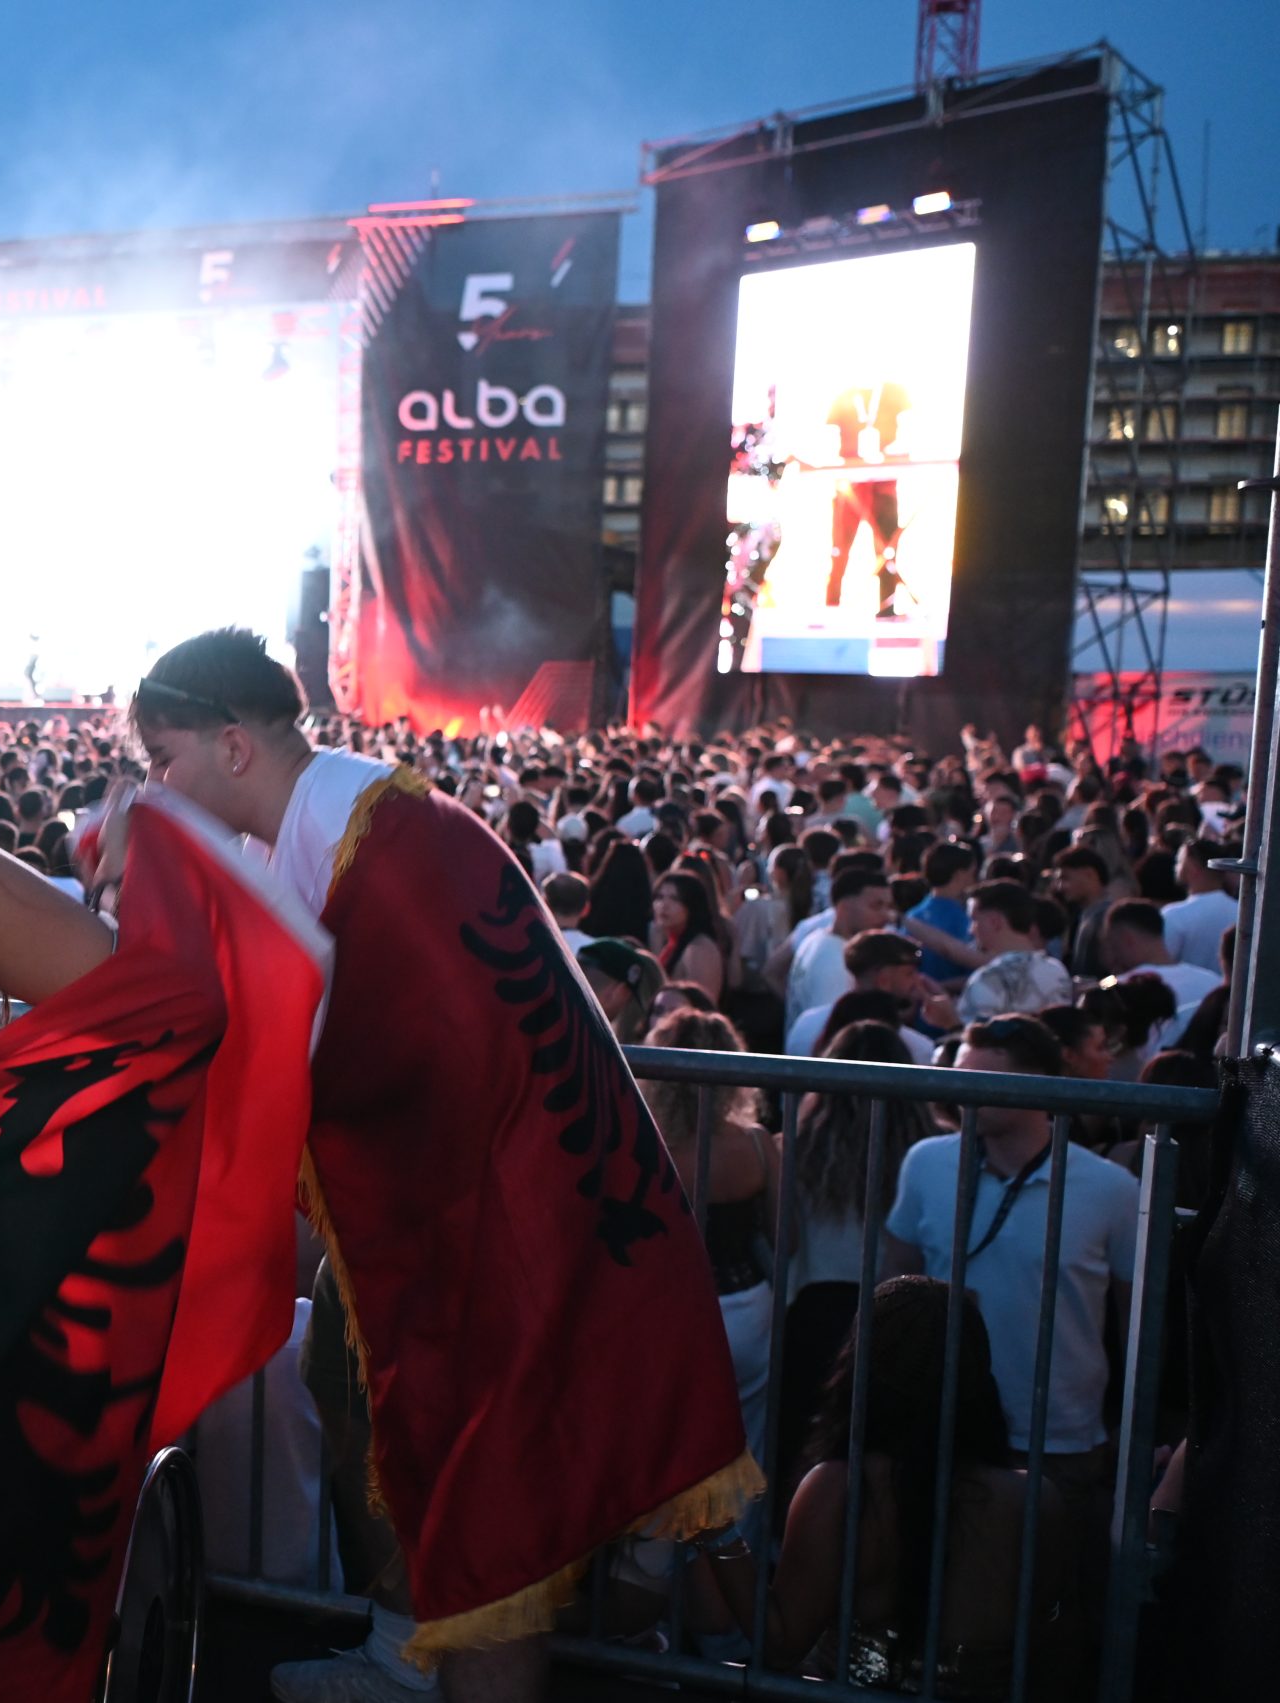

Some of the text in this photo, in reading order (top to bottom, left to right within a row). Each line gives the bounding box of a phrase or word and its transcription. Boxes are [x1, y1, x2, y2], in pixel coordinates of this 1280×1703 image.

[457, 272, 514, 352] 5
[398, 378, 566, 431] alba
[397, 436, 563, 465] FESTIVAL
